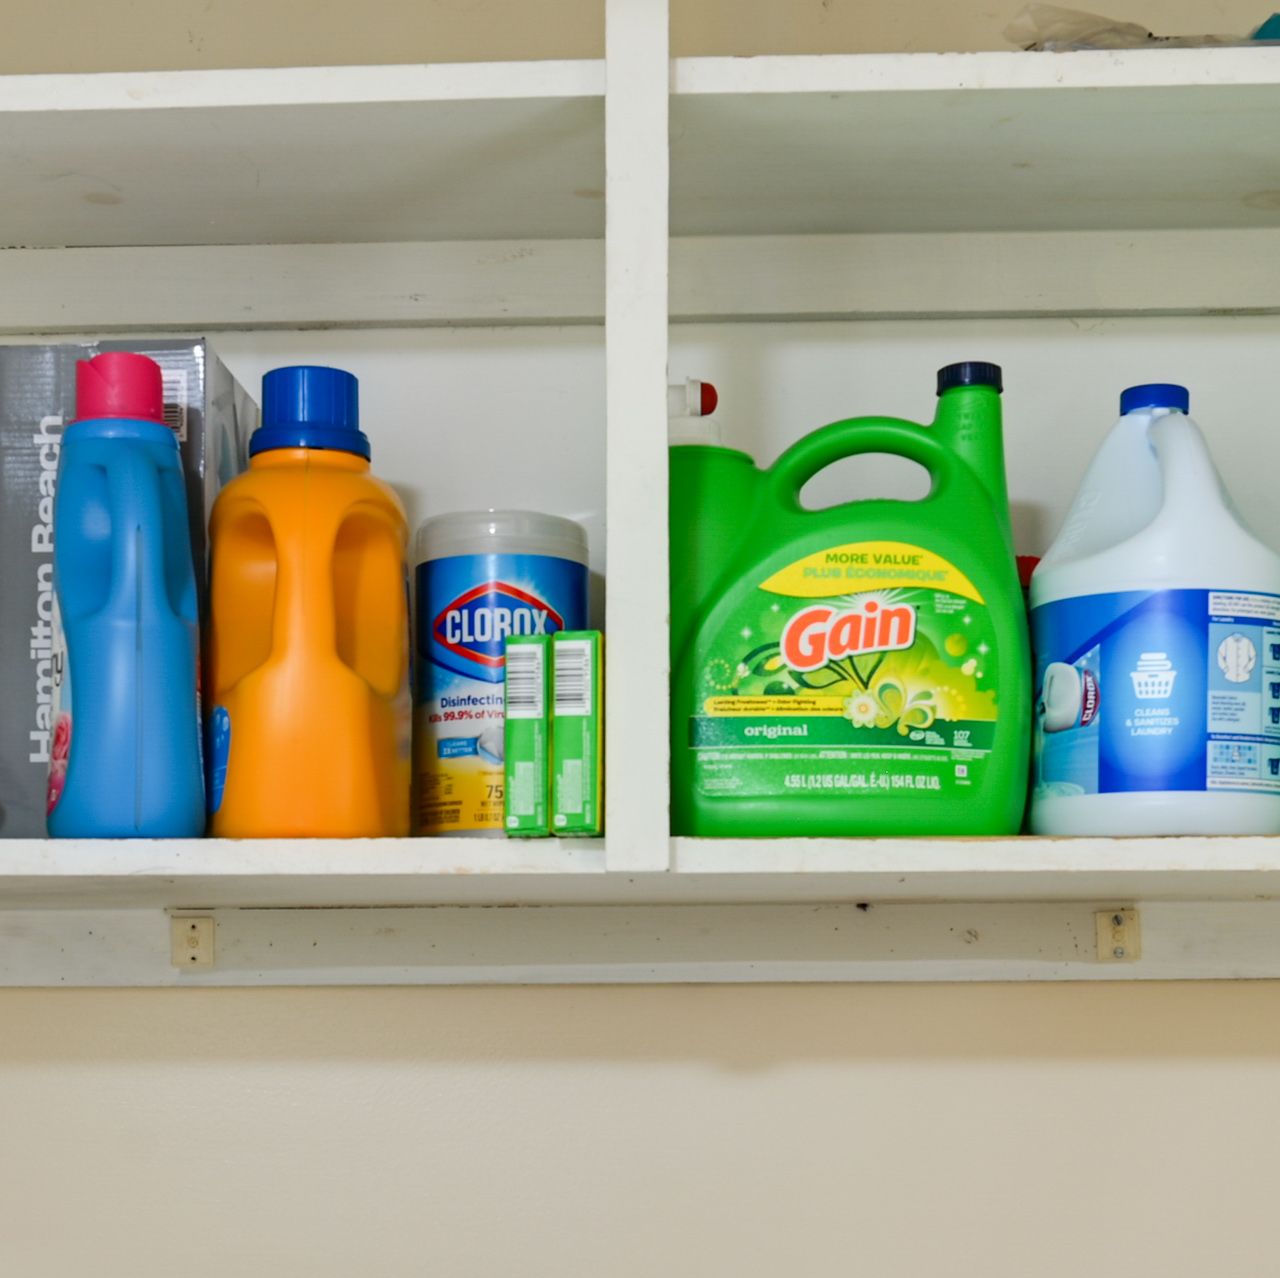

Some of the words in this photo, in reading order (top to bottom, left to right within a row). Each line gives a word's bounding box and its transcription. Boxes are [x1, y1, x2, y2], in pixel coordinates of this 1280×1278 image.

[31, 415, 63, 553] Beach
[825, 553, 868, 564] MORE
[803, 567, 841, 579] PLUS
[446, 607, 548, 644] CLOROX
[783, 600, 914, 669] Gain
[29, 563, 54, 763] Hamilton
[440, 694, 505, 709] Disinfectin
[1082, 675, 1096, 721] CLOROX
[443, 709, 473, 722] 99.9%
[475, 709, 485, 719] of
[744, 724, 808, 739] original
[953, 730, 970, 740] 107
[486, 785, 504, 799] 75
